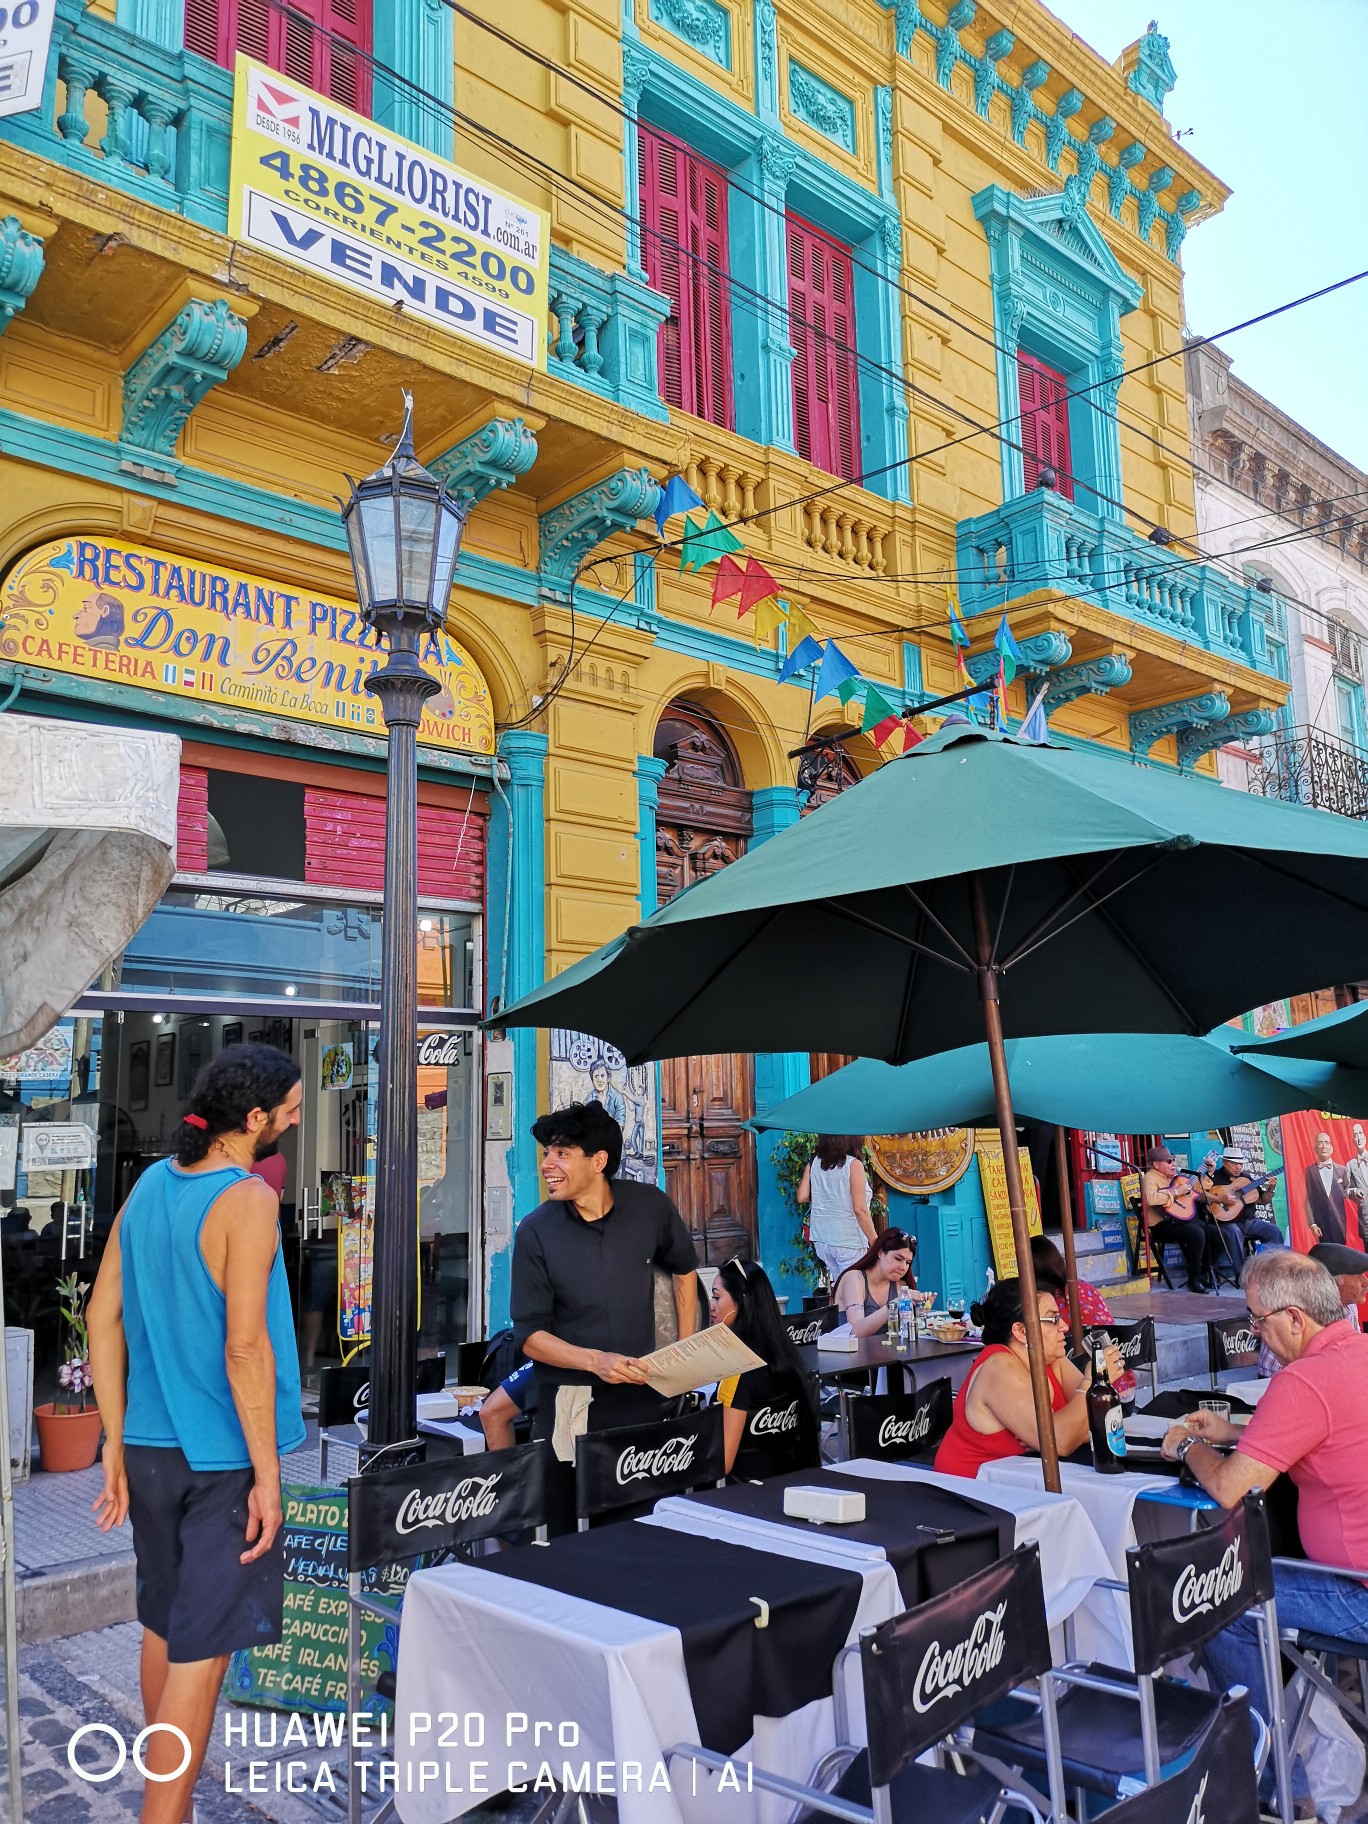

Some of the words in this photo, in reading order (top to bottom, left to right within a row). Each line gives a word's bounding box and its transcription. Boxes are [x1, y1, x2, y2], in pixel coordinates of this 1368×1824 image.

[256, 113, 280, 136] DESDE
[282, 126, 301, 145] 1956
[259, 150, 535, 295] 4867-2200
[283, 189, 449, 271] CORRIENTES
[457, 270, 509, 300] 4599
[269, 209, 519, 346] VENDE
[74, 539, 301, 631] RESTAURANT
[21, 635, 158, 682] CAFETERIA
[125, 605, 232, 668] Don
[242, 636, 380, 699] Benit
[220, 676, 278, 705] Caminito
[280, 690, 298, 709] La
[300, 693, 329, 716] Boca
[616, 1433, 699, 1485] Coca-Cola
[285, 1501, 340, 1526] PLATO
[395, 1472, 503, 1534] Coca-Cola
[284, 1534, 313, 1549] AFE
[283, 1589, 315, 1612] AFÉ
[1173, 1534, 1245, 1624] Coca-Cola
[257, 1668, 323, 1696] TE-CAFÉ
[912, 1598, 1008, 1713] Coca-Cola
